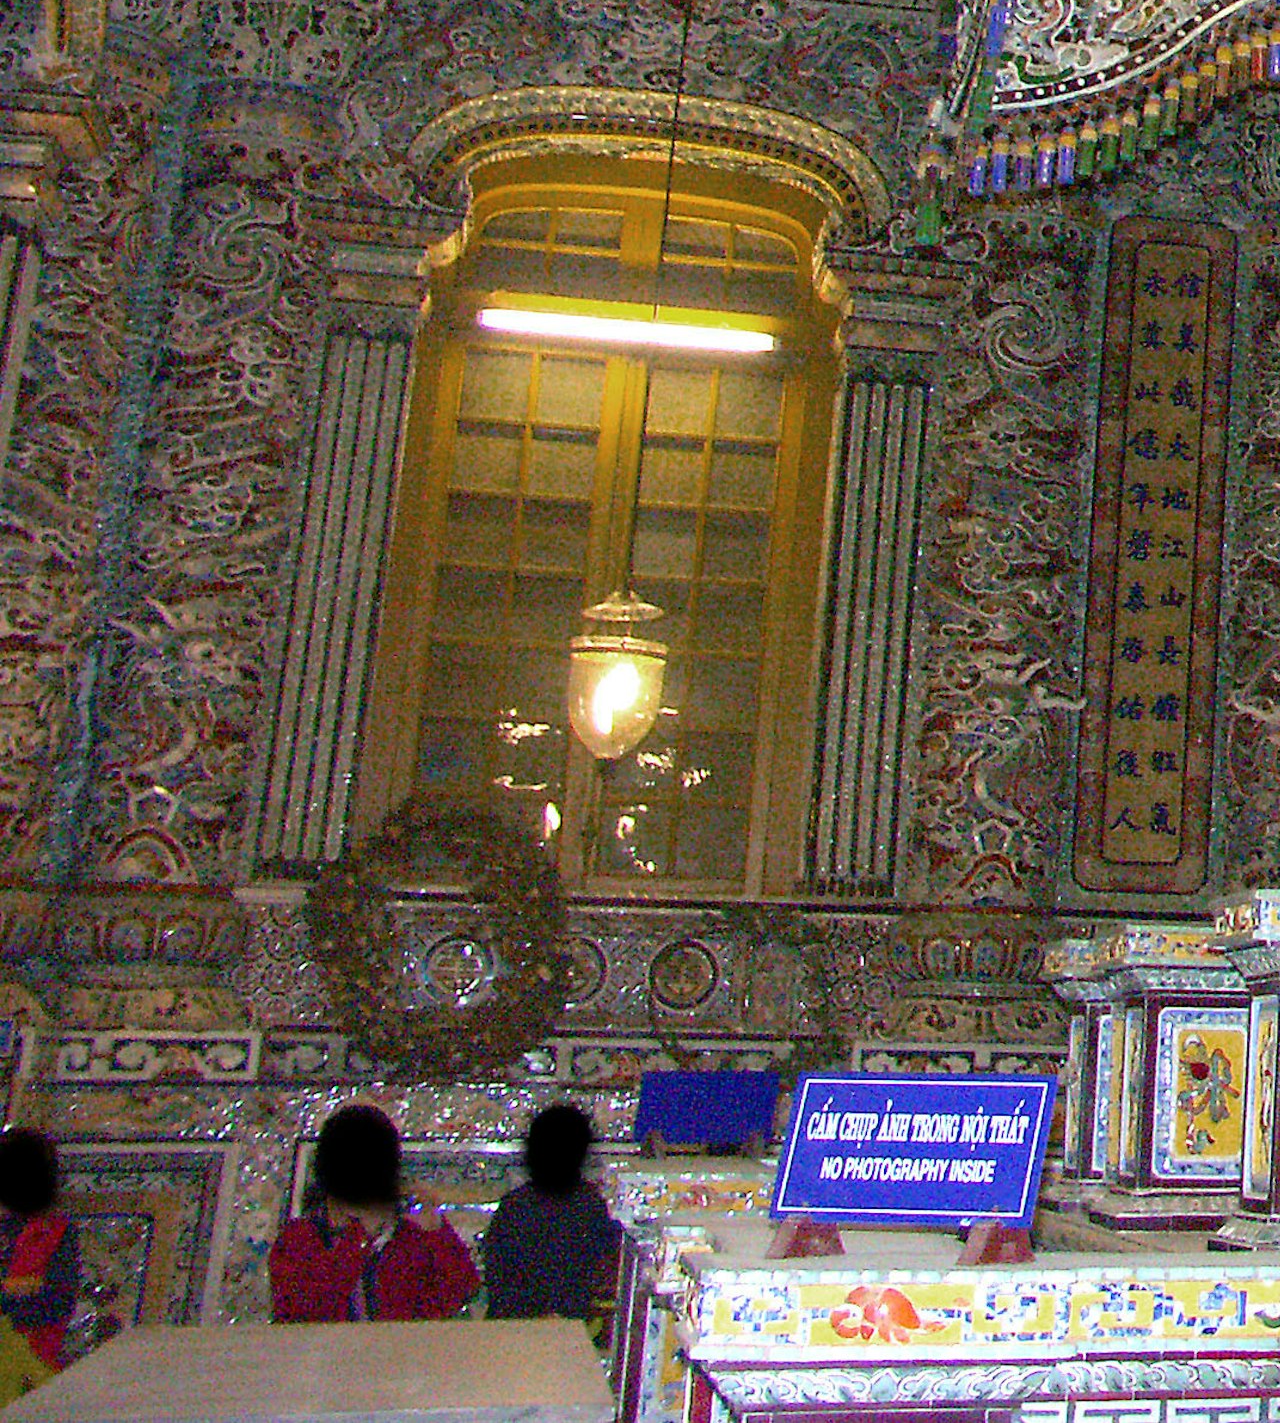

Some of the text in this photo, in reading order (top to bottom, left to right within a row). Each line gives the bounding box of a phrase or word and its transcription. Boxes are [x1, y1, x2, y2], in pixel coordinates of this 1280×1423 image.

[807, 1096, 841, 1141] CẤM
[840, 1112, 879, 1149] CHỤP
[910, 1113, 961, 1143] TRONG
[959, 1106, 990, 1152] NỘI
[988, 1099, 1030, 1144] THẤT
[819, 1156, 997, 1183] NO PHOTOGRAPHY INSIDE
